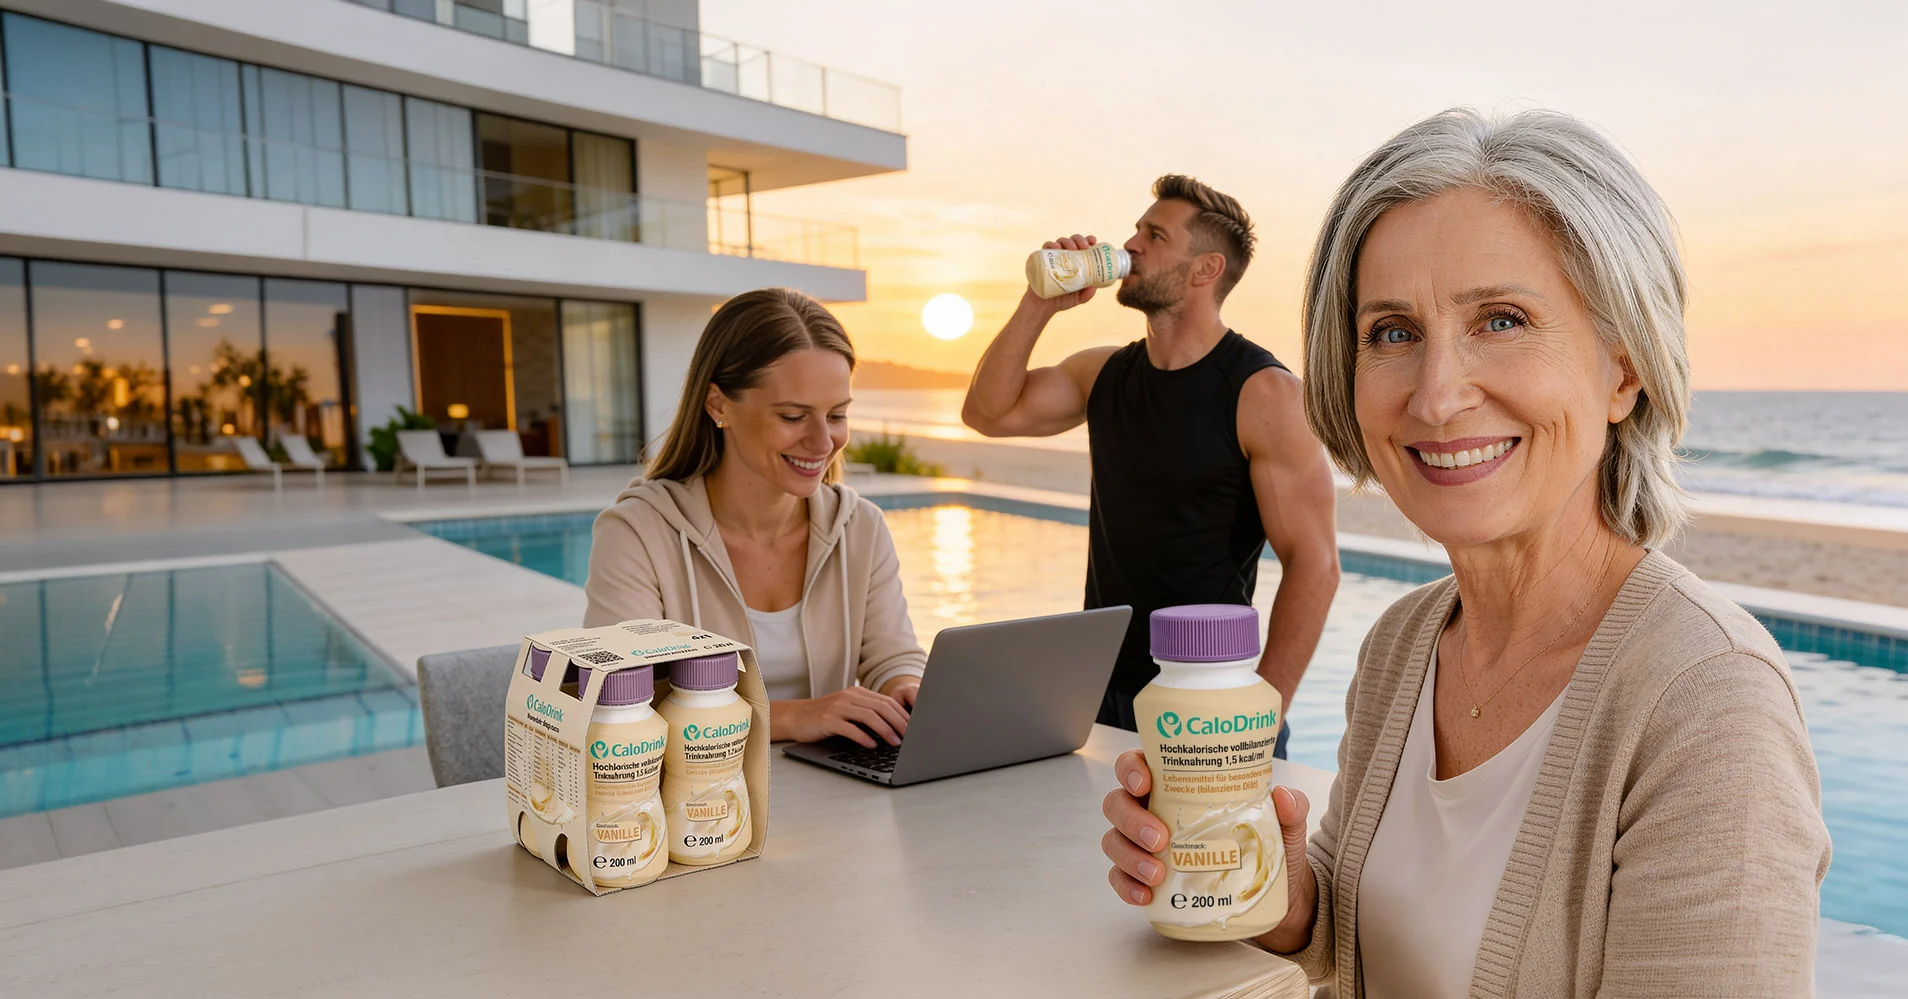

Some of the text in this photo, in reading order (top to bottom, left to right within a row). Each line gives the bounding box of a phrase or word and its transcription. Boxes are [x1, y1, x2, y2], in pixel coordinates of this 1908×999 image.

[533, 699, 564, 723] CaloDrink
[703, 718, 749, 739] CaloDrink
[1186, 710, 1277, 735] CaloDrink
[611, 735, 666, 757] CaloDrink
[1159, 736, 1276, 754] Hochkalorische vollbilanzierte
[1161, 751, 1265, 767] Trinknahrung 1,5 kcal/ml
[1163, 774, 1215, 782] Lebensmittel
[1216, 773, 1227, 782] für
[1228, 770, 1262, 781] besondere
[1164, 780, 1259, 795] Zwecke (bilanzierte Diät)
[686, 805, 726, 818] VANILLE
[596, 827, 640, 840] VANILLE
[699, 837, 714, 846] 200
[714, 834, 724, 843] ml
[609, 858, 626, 868] 200
[626, 856, 637, 866] ml
[1172, 850, 1238, 866] VANILLE
[1191, 895, 1215, 908] 200
[1217, 894, 1232, 906] ml
